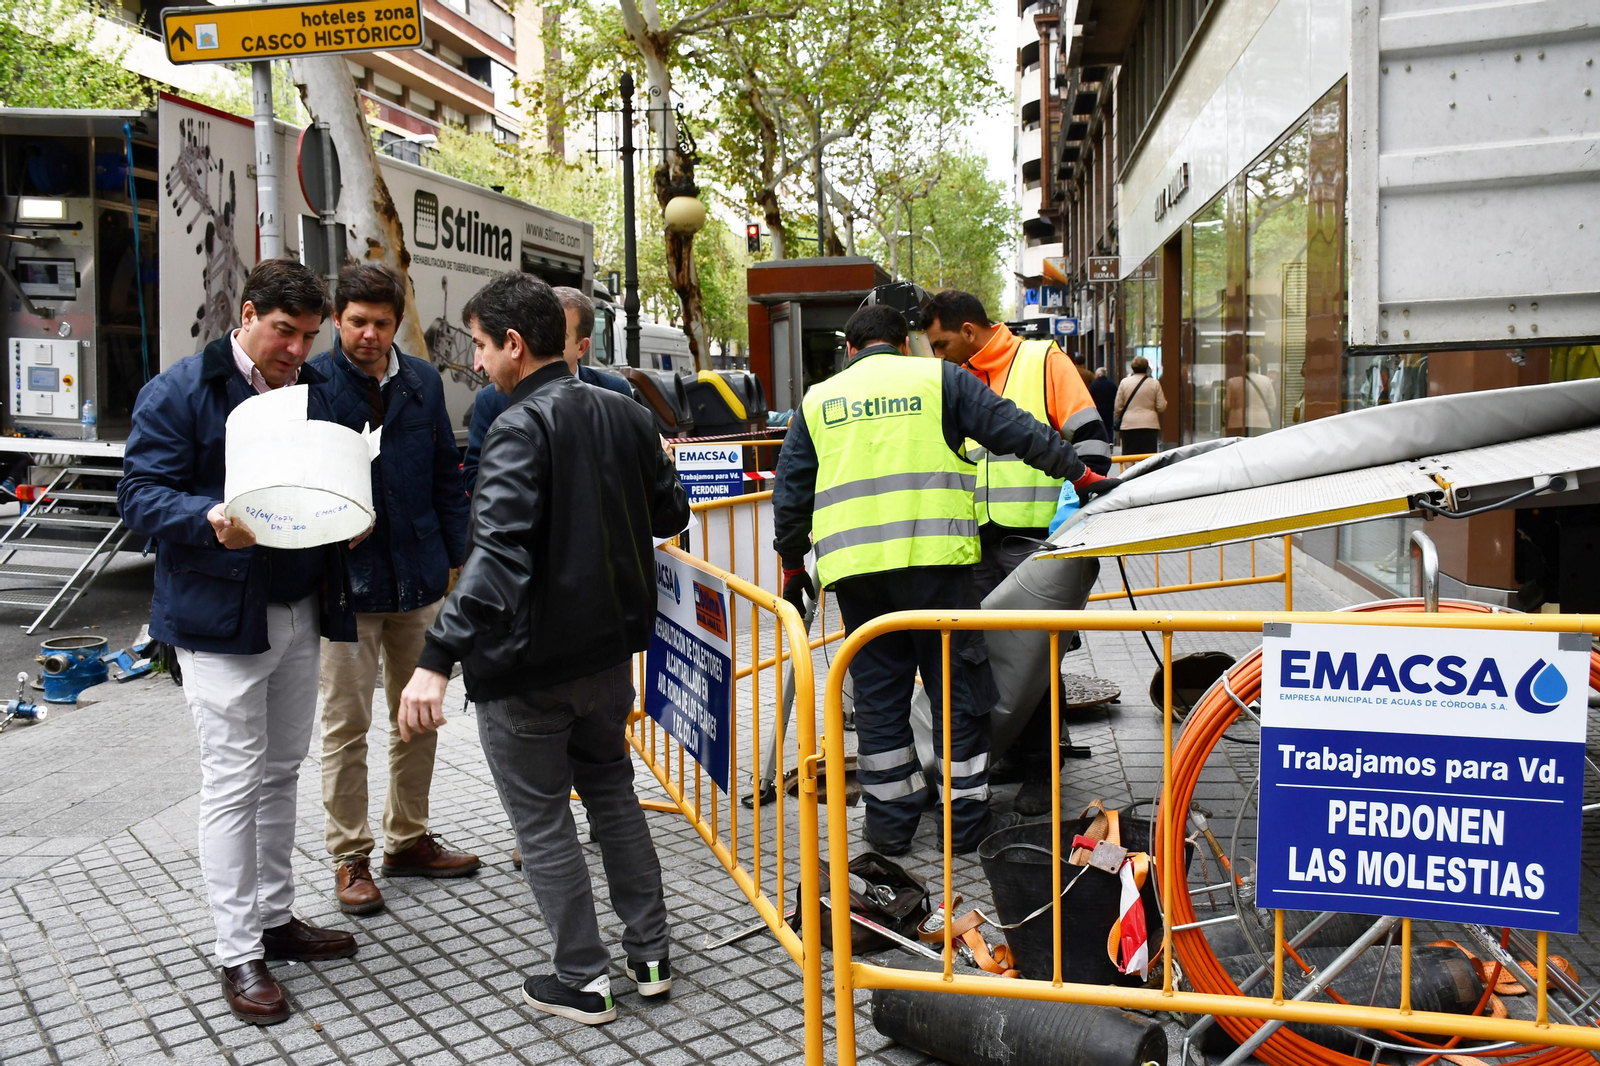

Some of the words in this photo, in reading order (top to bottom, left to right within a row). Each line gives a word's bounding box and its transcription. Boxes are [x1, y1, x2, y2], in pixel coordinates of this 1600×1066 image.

[301, 9, 366, 27] hoteles
[375, 7, 415, 21] zona
[241, 33, 306, 52] CASCO
[314, 24, 417, 46] HISTÓRICO
[441, 206, 512, 262] stlima
[526, 223, 581, 249] www.stlima.com
[447, 260, 453, 270] DE
[851, 396, 922, 418] stlima
[679, 451, 727, 461] EMACSA
[680, 473, 714, 481] Trabajamos
[691, 485, 729, 494] PERDONEN
[316, 504, 348, 517] EMACSA
[686, 636, 692, 661] DE
[692, 641, 723, 683] COLECTORES
[666, 650, 701, 696] ALCANTARILLADO
[702, 677, 709, 703] EN
[1280, 650, 1508, 698] EMACSA
[667, 678, 681, 709] RONDA
[681, 690, 688, 715] DE
[688, 695, 697, 722] LOS
[697, 702, 717, 742] TEJARES
[1279, 693, 1321, 702] EMPRESA
[1324, 695, 1373, 704] MUNICIPAL
[1375, 697, 1388, 705] DE
[1390, 698, 1422, 707] AGUAS
[1425, 700, 1438, 708] DE
[1440, 699, 1488, 710] CÓRDOBA
[1490, 703, 1508, 711] S.A.
[672, 710, 677, 732] Y
[683, 721, 699, 754] COLÓN
[1278, 744, 1436, 778] Trabajamos
[1446, 757, 1508, 784] para
[1518, 757, 1565, 784] Vd.
[1328, 800, 1505, 845] PERDONEN
[1288, 847, 1347, 884] LAS
[1357, 850, 1545, 900] MOLESTIAS
